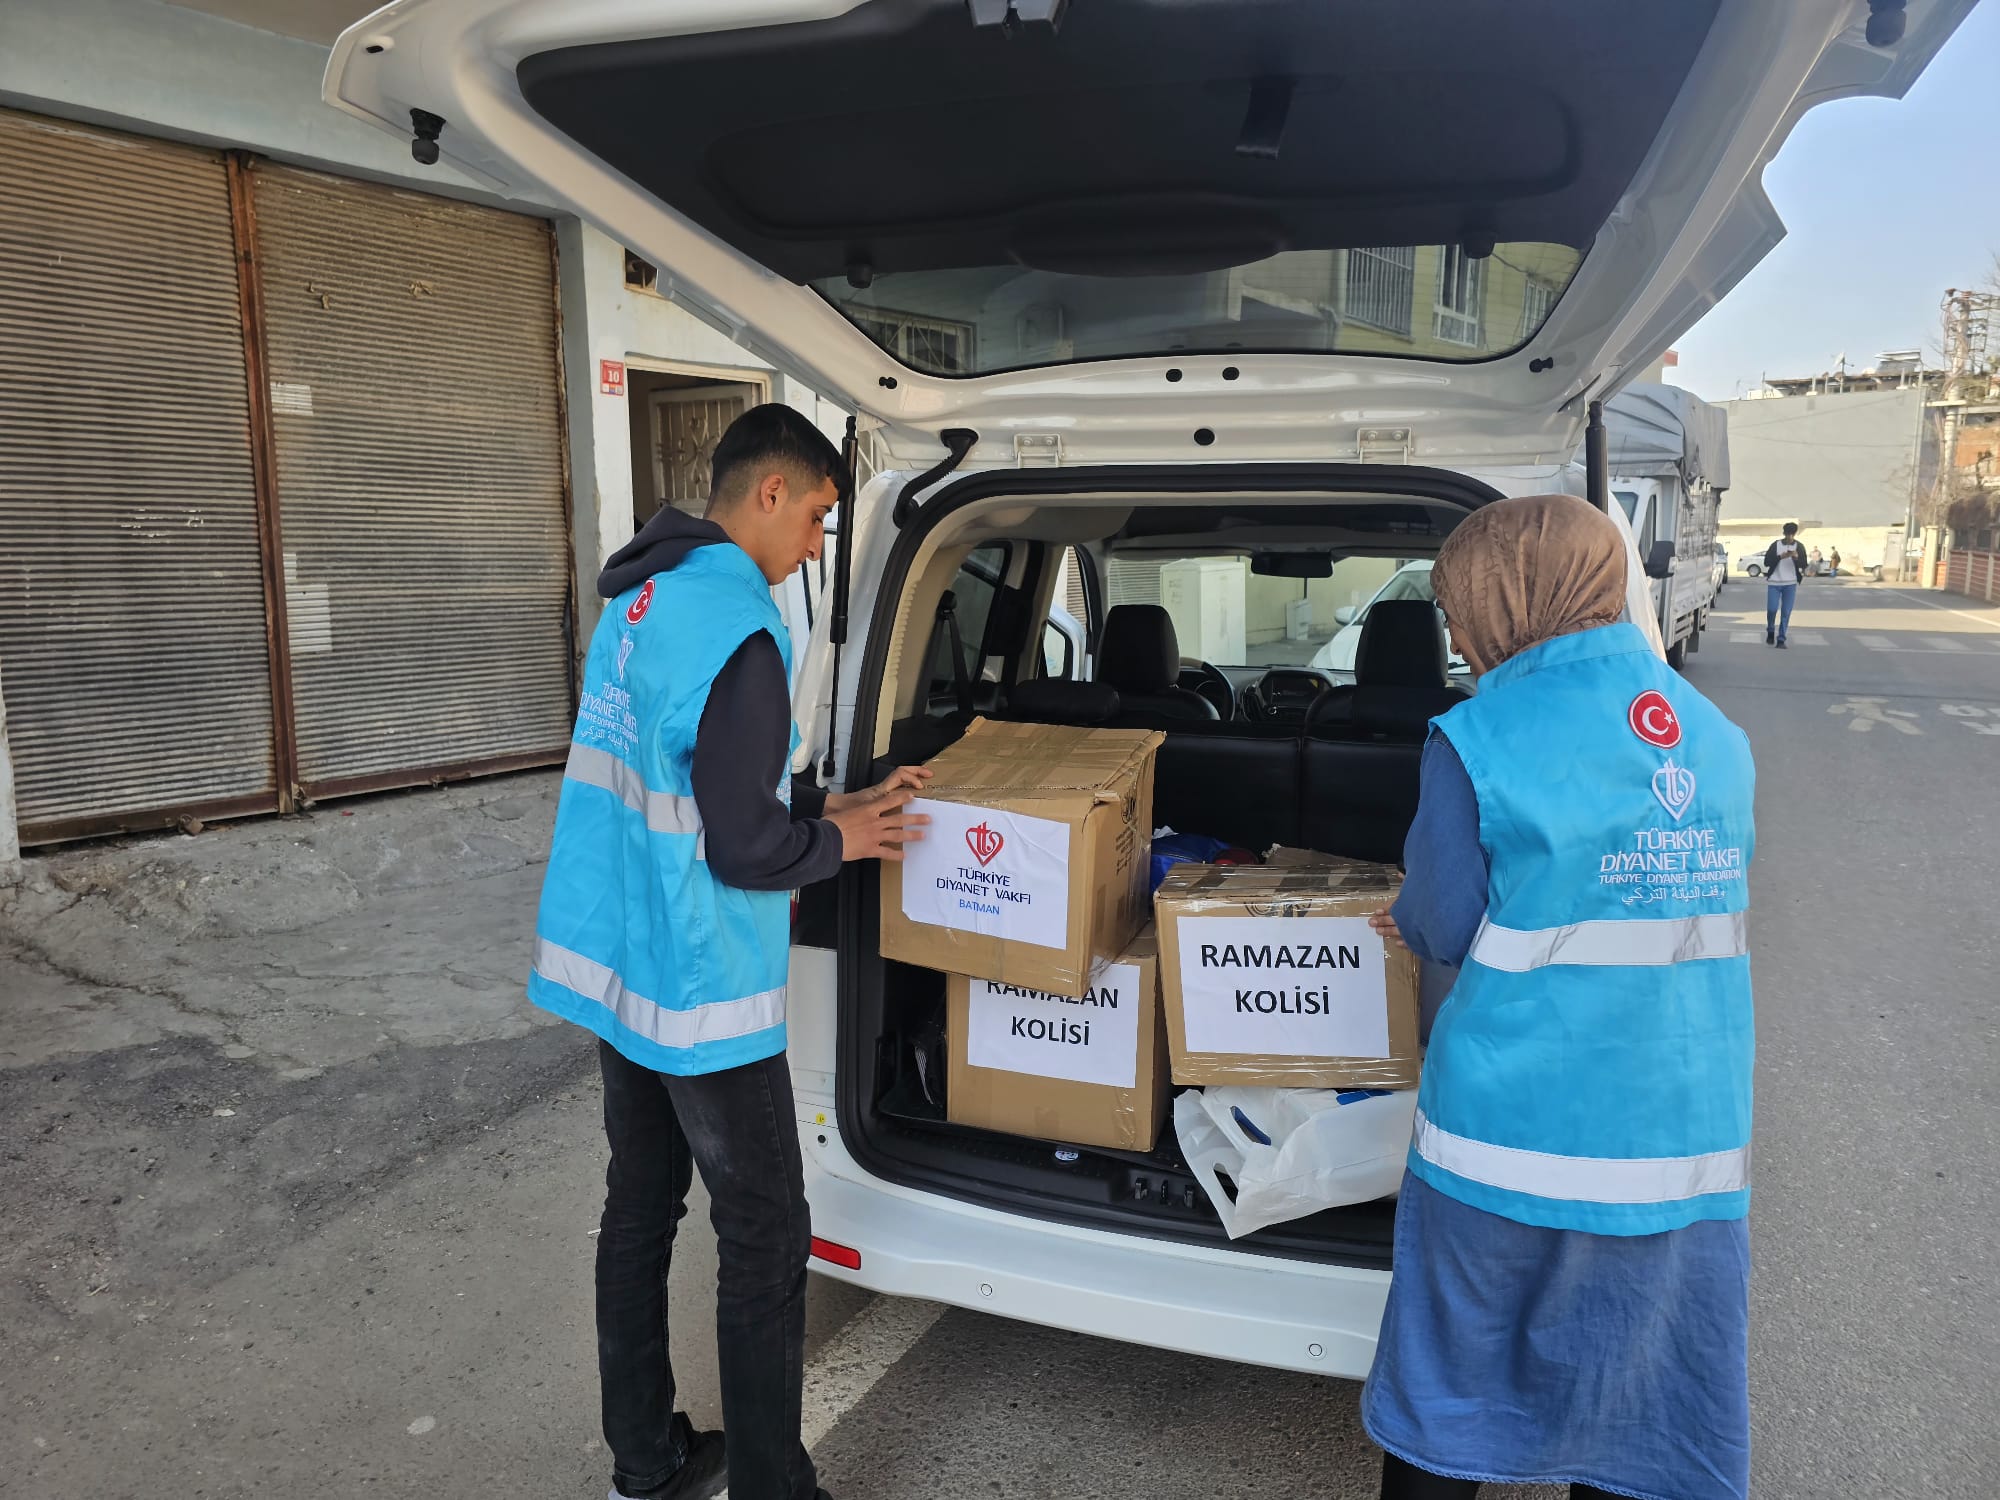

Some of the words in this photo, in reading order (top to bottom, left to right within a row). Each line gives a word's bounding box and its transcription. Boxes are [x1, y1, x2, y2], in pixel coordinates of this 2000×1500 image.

[608, 370, 620, 384] 10
[1634, 826, 1715, 850] TÜRKİYE
[1600, 850, 1691, 873] DİYANET
[1697, 847, 1740, 869] VAKFI
[957, 866, 1011, 887] TÜRKİYE
[936, 877, 989, 897] DİYANET
[995, 889, 1031, 904] VAKFI
[959, 899, 1000, 915] BATMAN
[1201, 944, 1360, 969] RAMAZAN
[1235, 985, 1330, 1015] KOLİSİ
[1011, 1015, 1090, 1046] KOLİSİ
